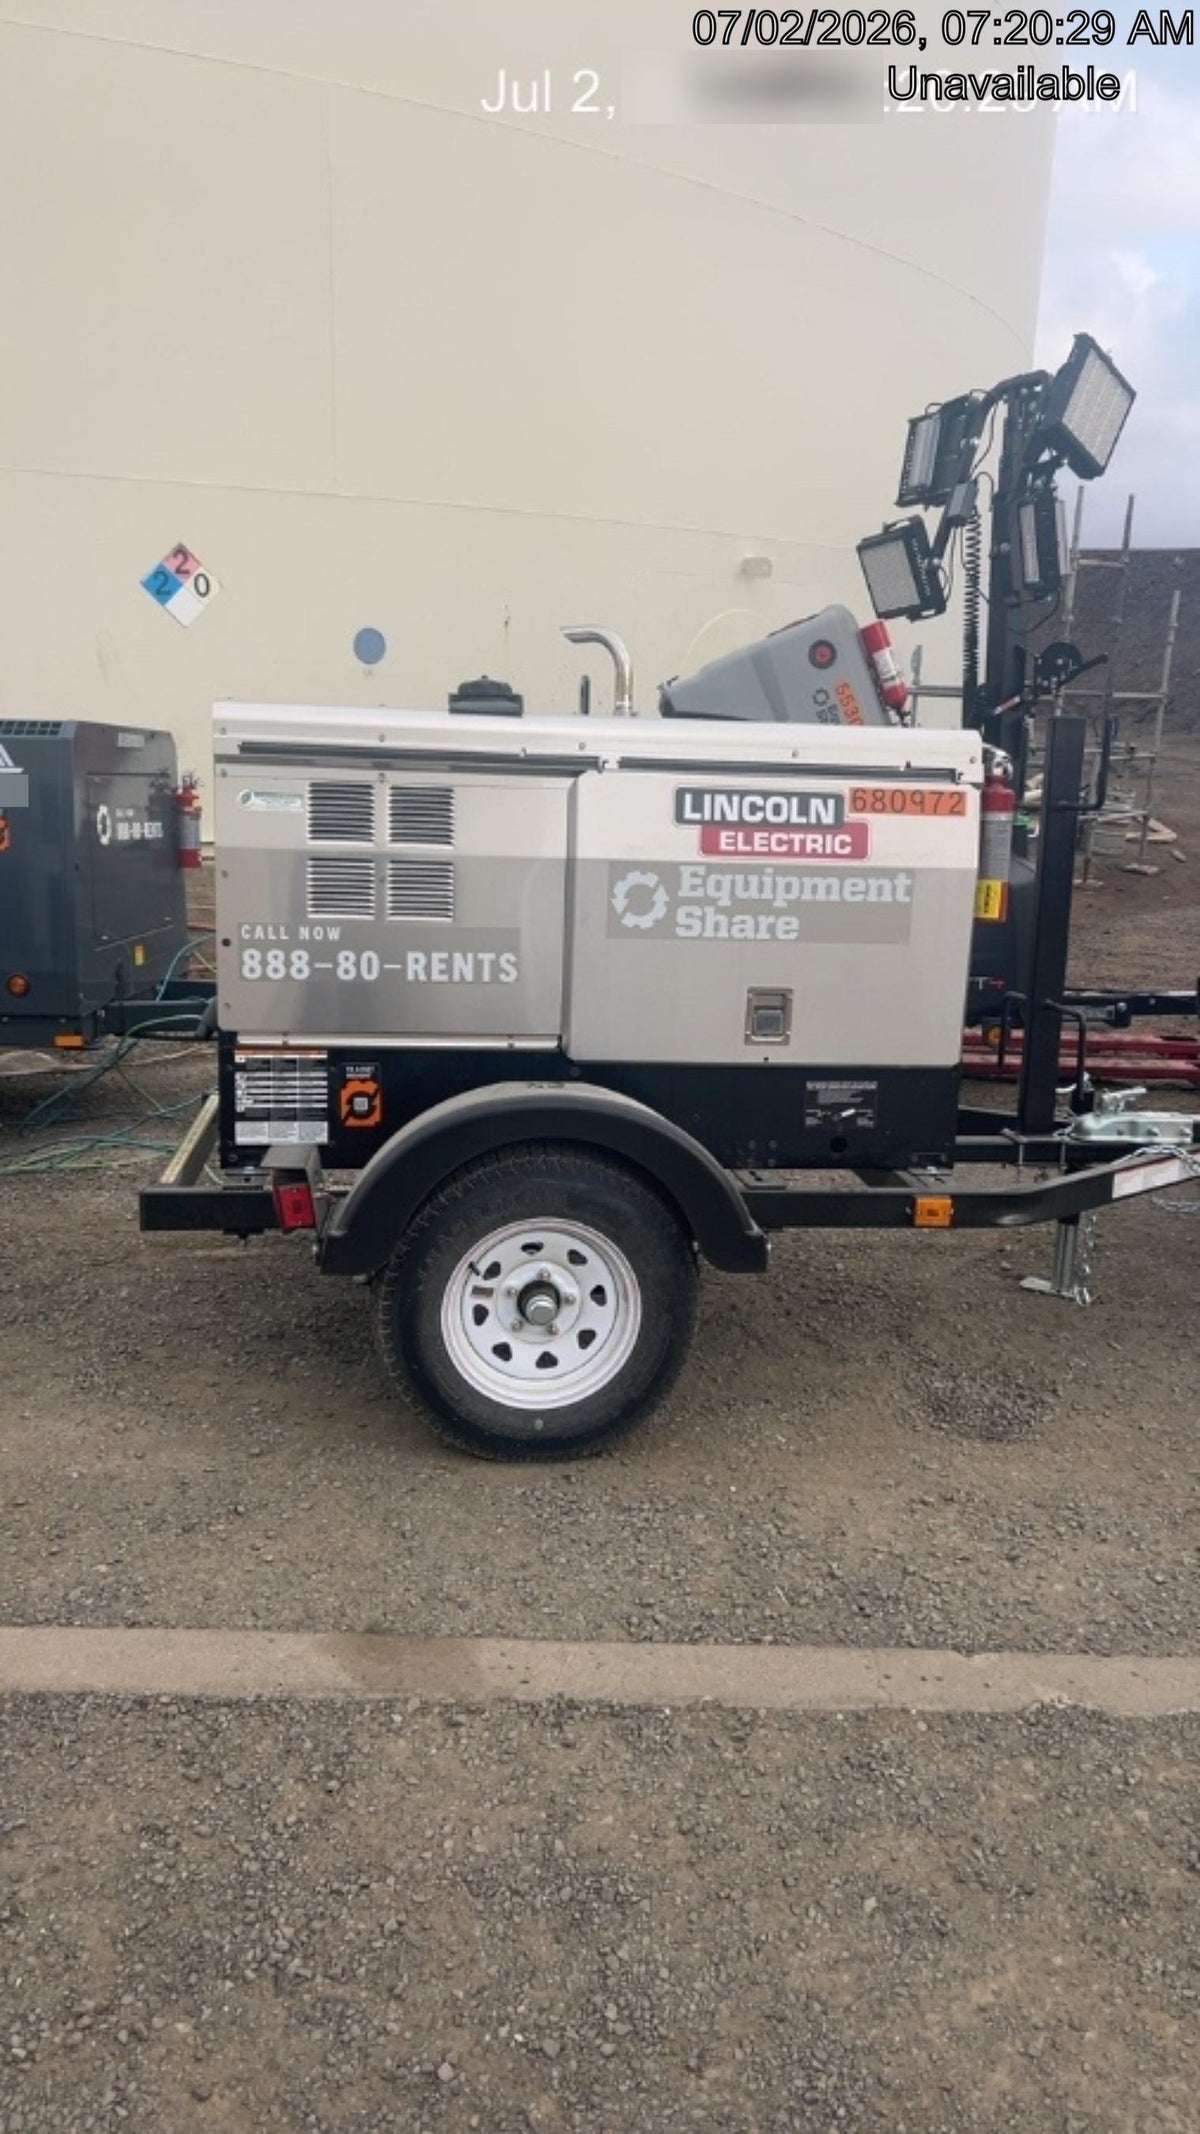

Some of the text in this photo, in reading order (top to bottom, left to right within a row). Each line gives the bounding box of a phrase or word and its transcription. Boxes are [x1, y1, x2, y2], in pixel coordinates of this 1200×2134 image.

[172, 549, 191, 575] 2
[153, 570, 172, 596] 2
[194, 573, 210, 598] 0
[684, 793, 835, 825] LINCOLN
[852, 788, 964, 815] 680972
[719, 831, 852, 855] ELECTRIC
[678, 865, 912, 907] Equipment
[241, 924, 342, 942] CALL NOW
[675, 905, 799, 941] Share
[241, 948, 518, 983] 888-80-RENTS
